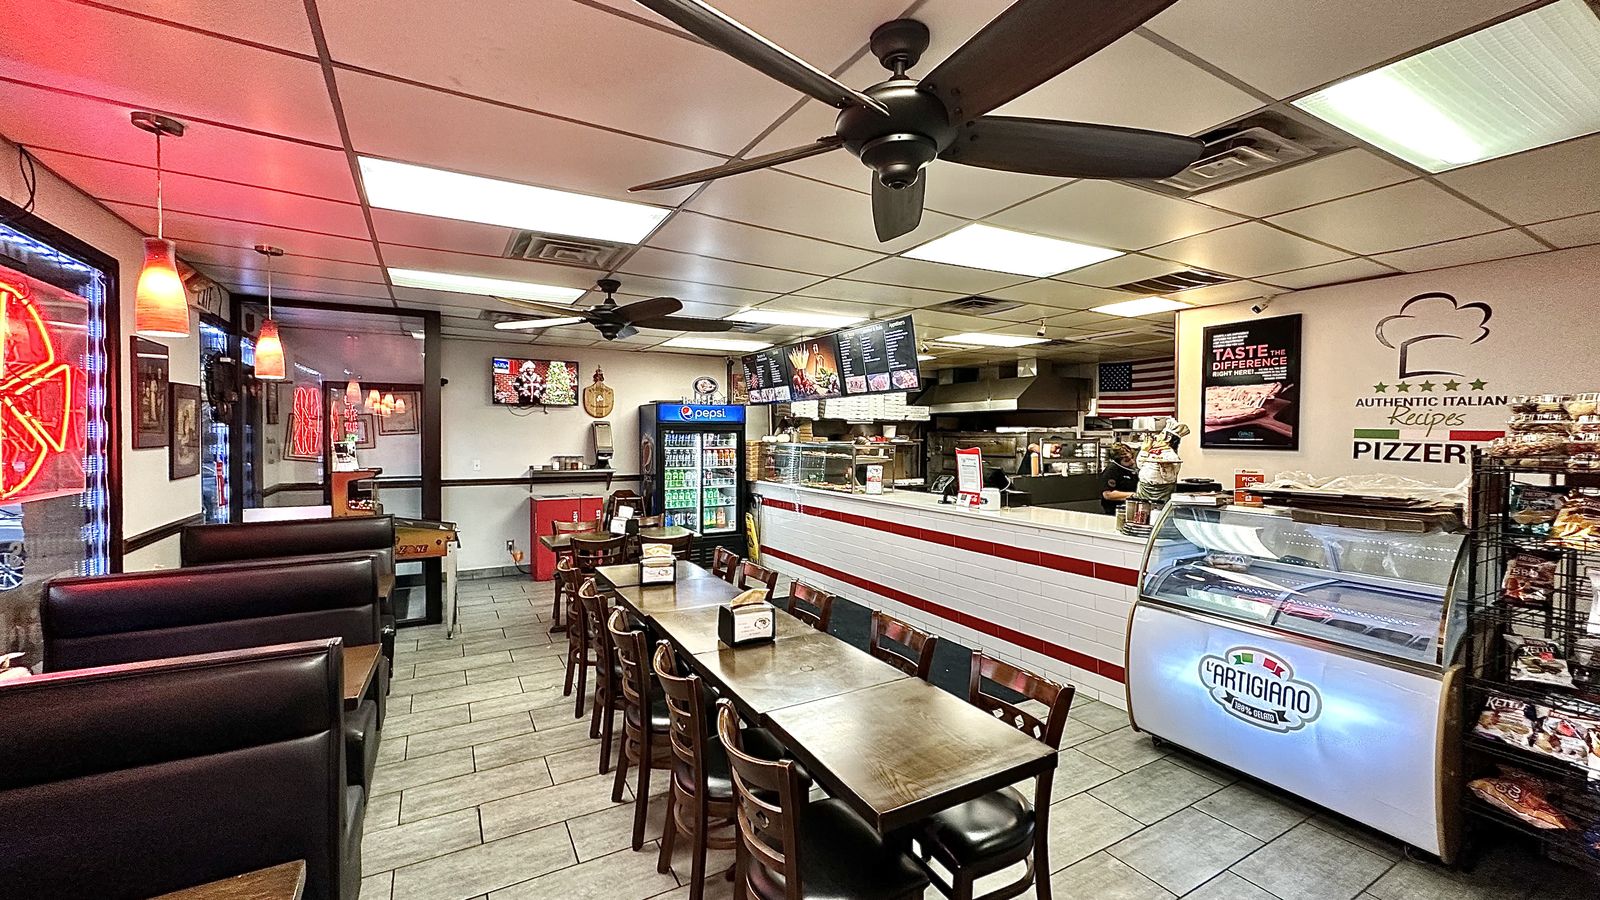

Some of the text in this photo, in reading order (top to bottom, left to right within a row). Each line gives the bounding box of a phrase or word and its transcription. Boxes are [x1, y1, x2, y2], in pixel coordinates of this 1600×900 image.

[1212, 344, 1269, 361] TASTE
[1212, 356, 1288, 371] DIFFERENCE
[1212, 370, 1233, 378] RIGHT
[1355, 395, 1508, 407] AUTHENTIC ITALIAN
[695, 408, 727, 420] pepsi
[1387, 405, 1467, 437] Recipes
[1353, 441, 1478, 464] PIZZER
[1206, 660, 1311, 714] L'ARTIGIANO
[1485, 696, 1529, 712] KETTLE
[1253, 709, 1275, 722] GELATO
